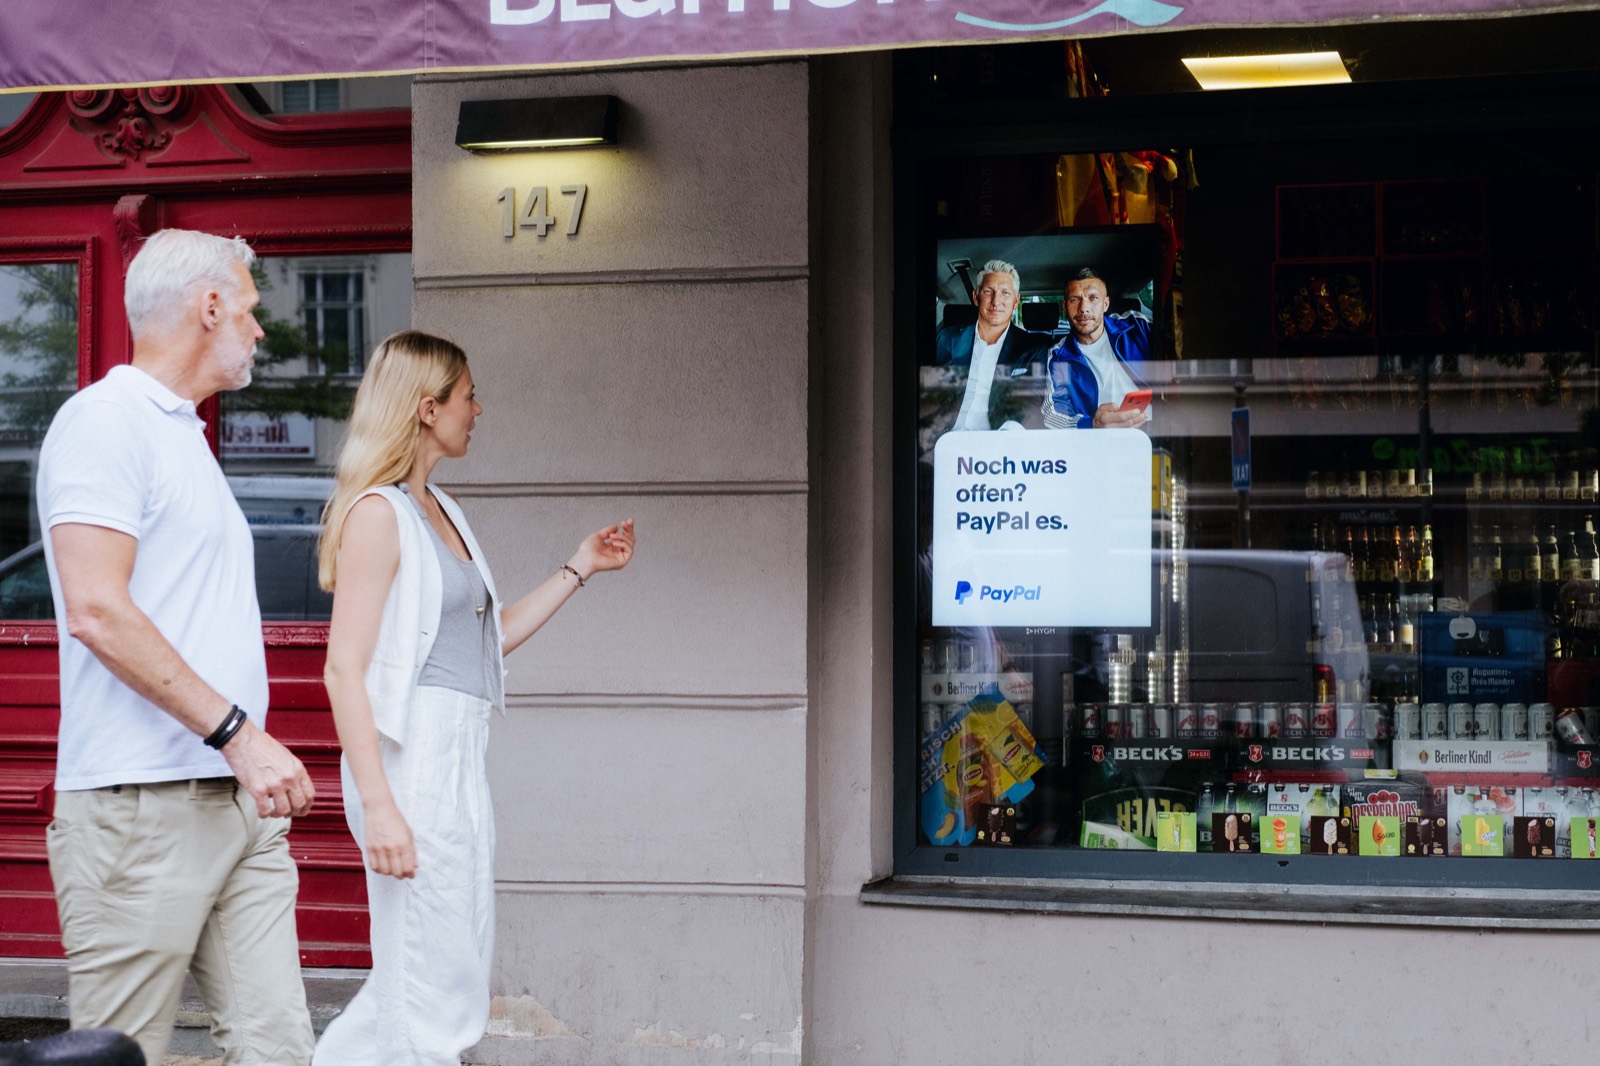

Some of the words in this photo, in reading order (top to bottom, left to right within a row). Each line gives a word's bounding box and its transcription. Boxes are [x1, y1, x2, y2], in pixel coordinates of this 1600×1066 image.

[497, 184, 588, 238] 147
[957, 456, 1016, 475] Noch
[1021, 460, 1067, 474] was
[956, 483, 1027, 502] offen?
[956, 511, 1030, 534] PayPal
[1035, 515, 1068, 530] es.
[979, 585, 1041, 603] PayPal
[948, 682, 977, 695] Berliner
[1113, 744, 1183, 760] BECK'S
[1271, 745, 1345, 760] BECK'S
[1435, 750, 1468, 764] Berliner
[1469, 750, 1492, 764] Kindl
